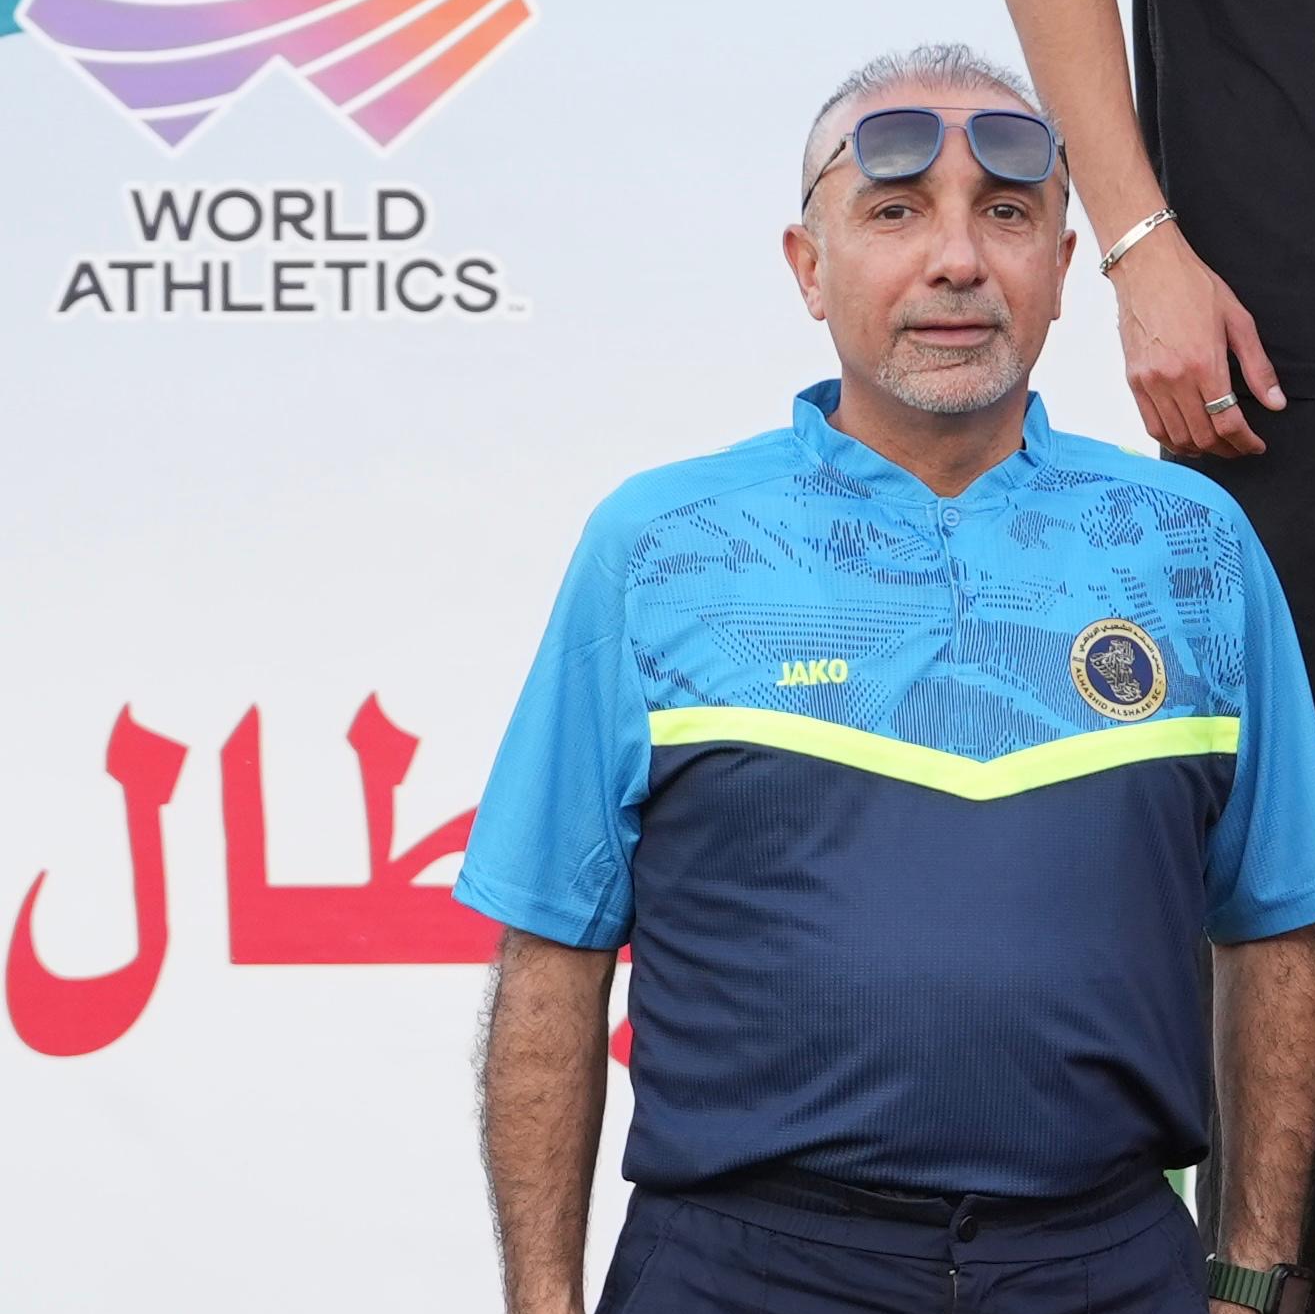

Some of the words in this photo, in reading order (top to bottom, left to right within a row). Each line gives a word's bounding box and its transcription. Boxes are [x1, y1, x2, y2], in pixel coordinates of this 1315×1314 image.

[131, 187, 426, 243] WORLD
[57, 257, 500, 314] ATHLETICS
[776, 659, 848, 686] JAKO
[1075, 666, 1109, 711] ALHASHID
[1109, 700, 1154, 717] ALSHAABI
